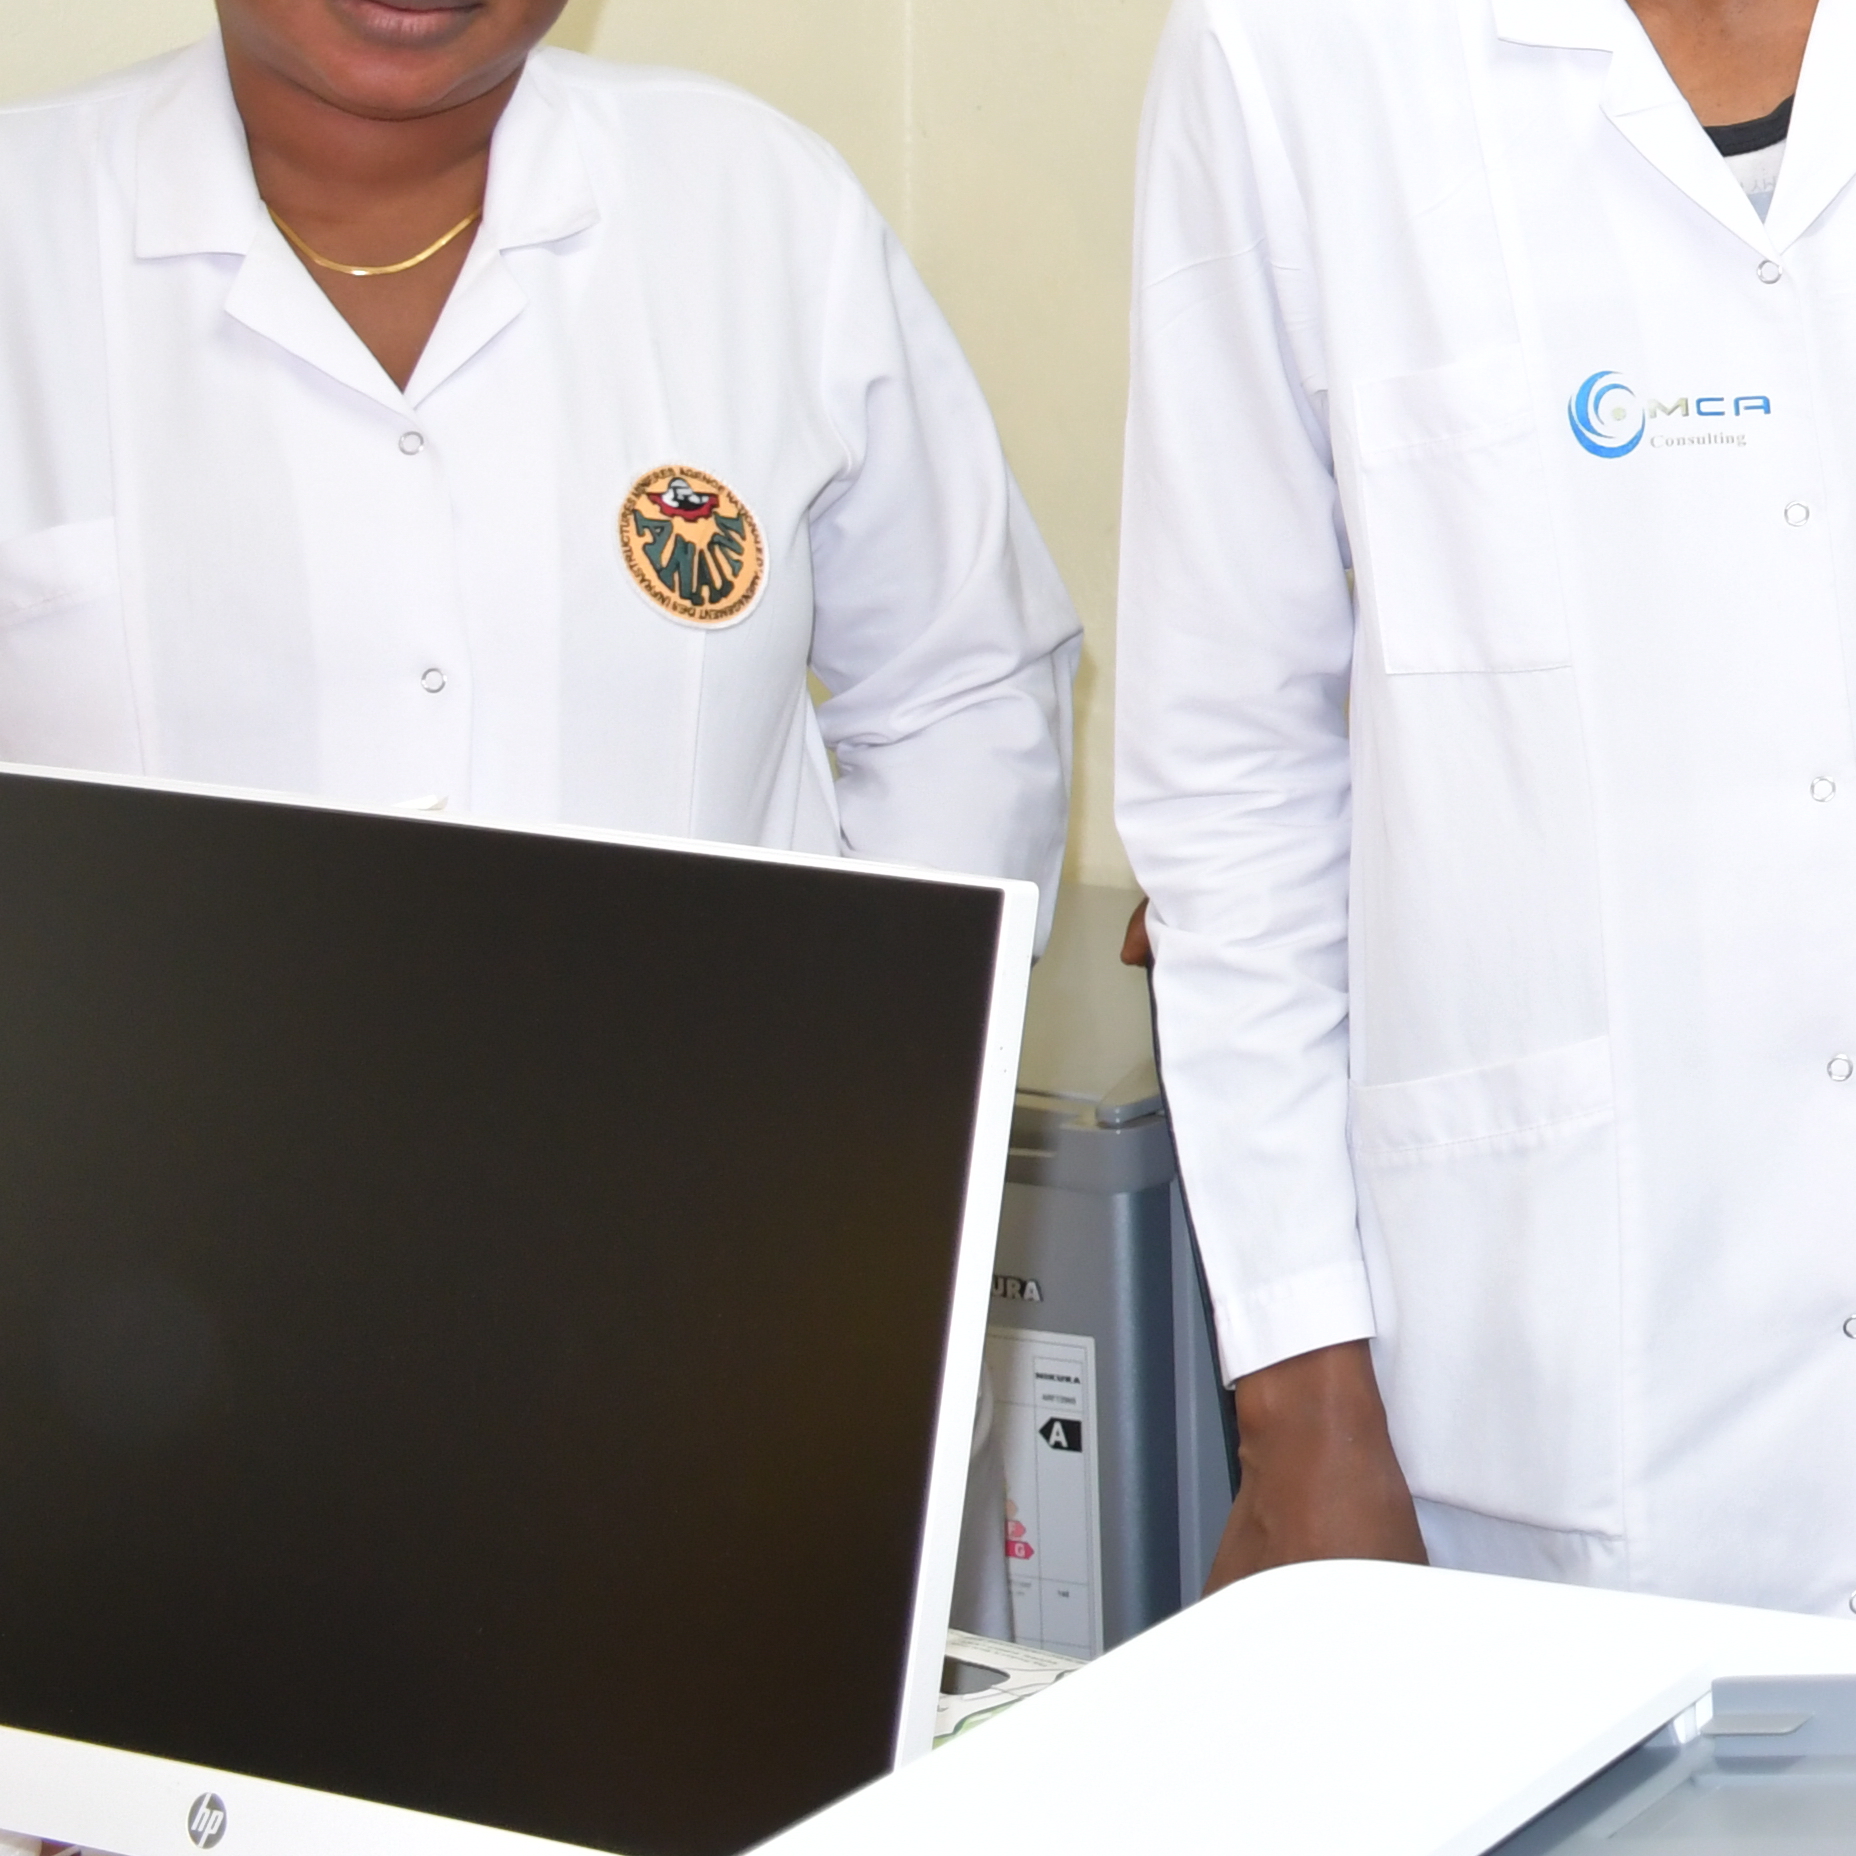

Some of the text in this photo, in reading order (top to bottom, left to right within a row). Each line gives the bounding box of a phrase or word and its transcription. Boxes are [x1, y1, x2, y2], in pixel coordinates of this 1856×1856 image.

[1647, 395, 1771, 419] MCA
[1650, 431, 1747, 449] Consulting
[633, 509, 747, 606] ANAIM
[1049, 1421, 1069, 1448] A
[1014, 1542, 1026, 1558] G
[191, 1792, 224, 1848] hp
